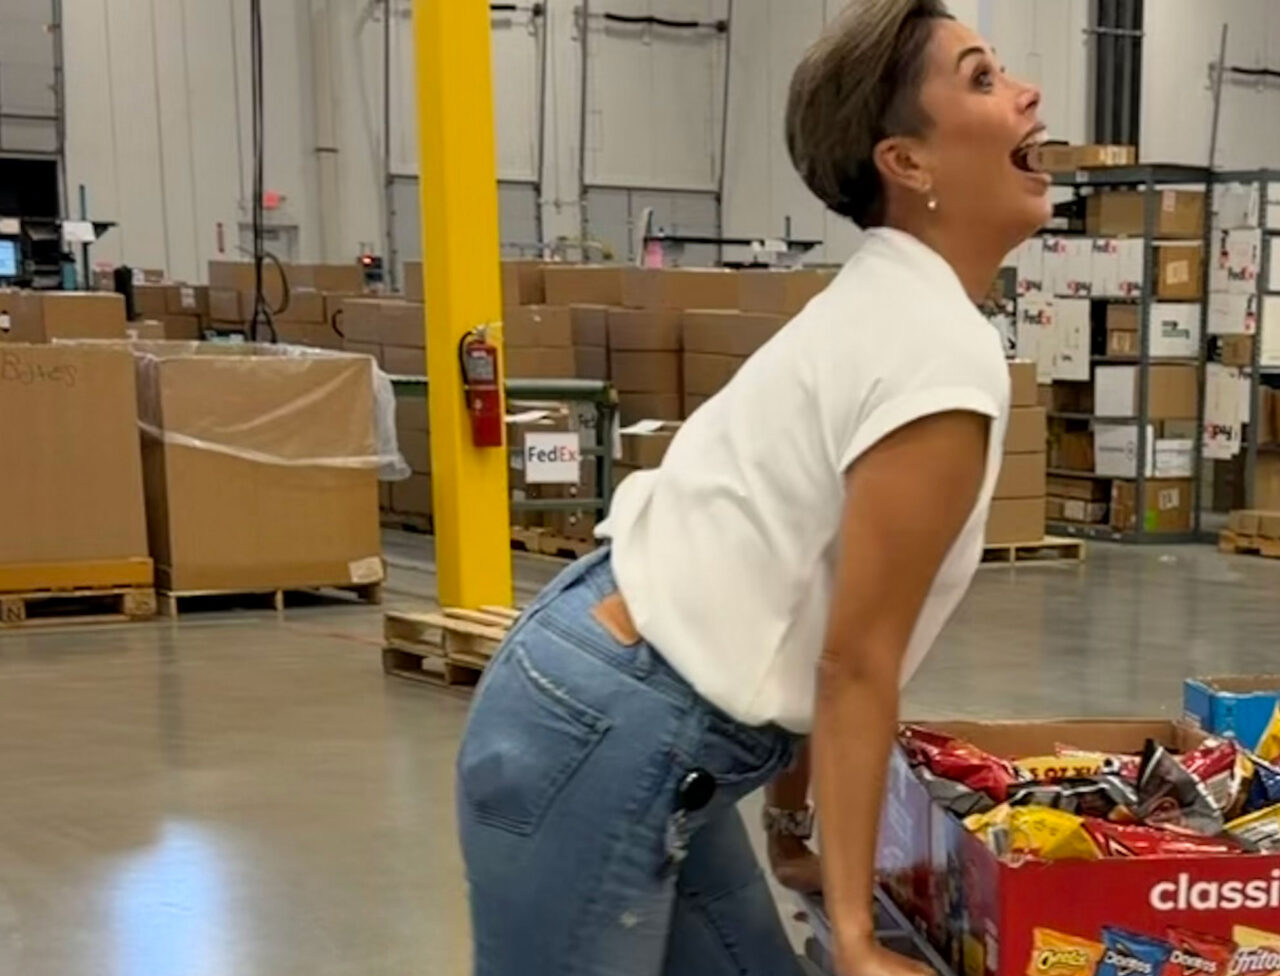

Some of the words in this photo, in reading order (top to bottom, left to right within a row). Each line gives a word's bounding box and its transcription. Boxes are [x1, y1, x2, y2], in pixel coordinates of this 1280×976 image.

[528, 445, 577, 462] FedEx
[1104, 950, 1152, 974] Doritos
[1170, 950, 1217, 973] Doritos
